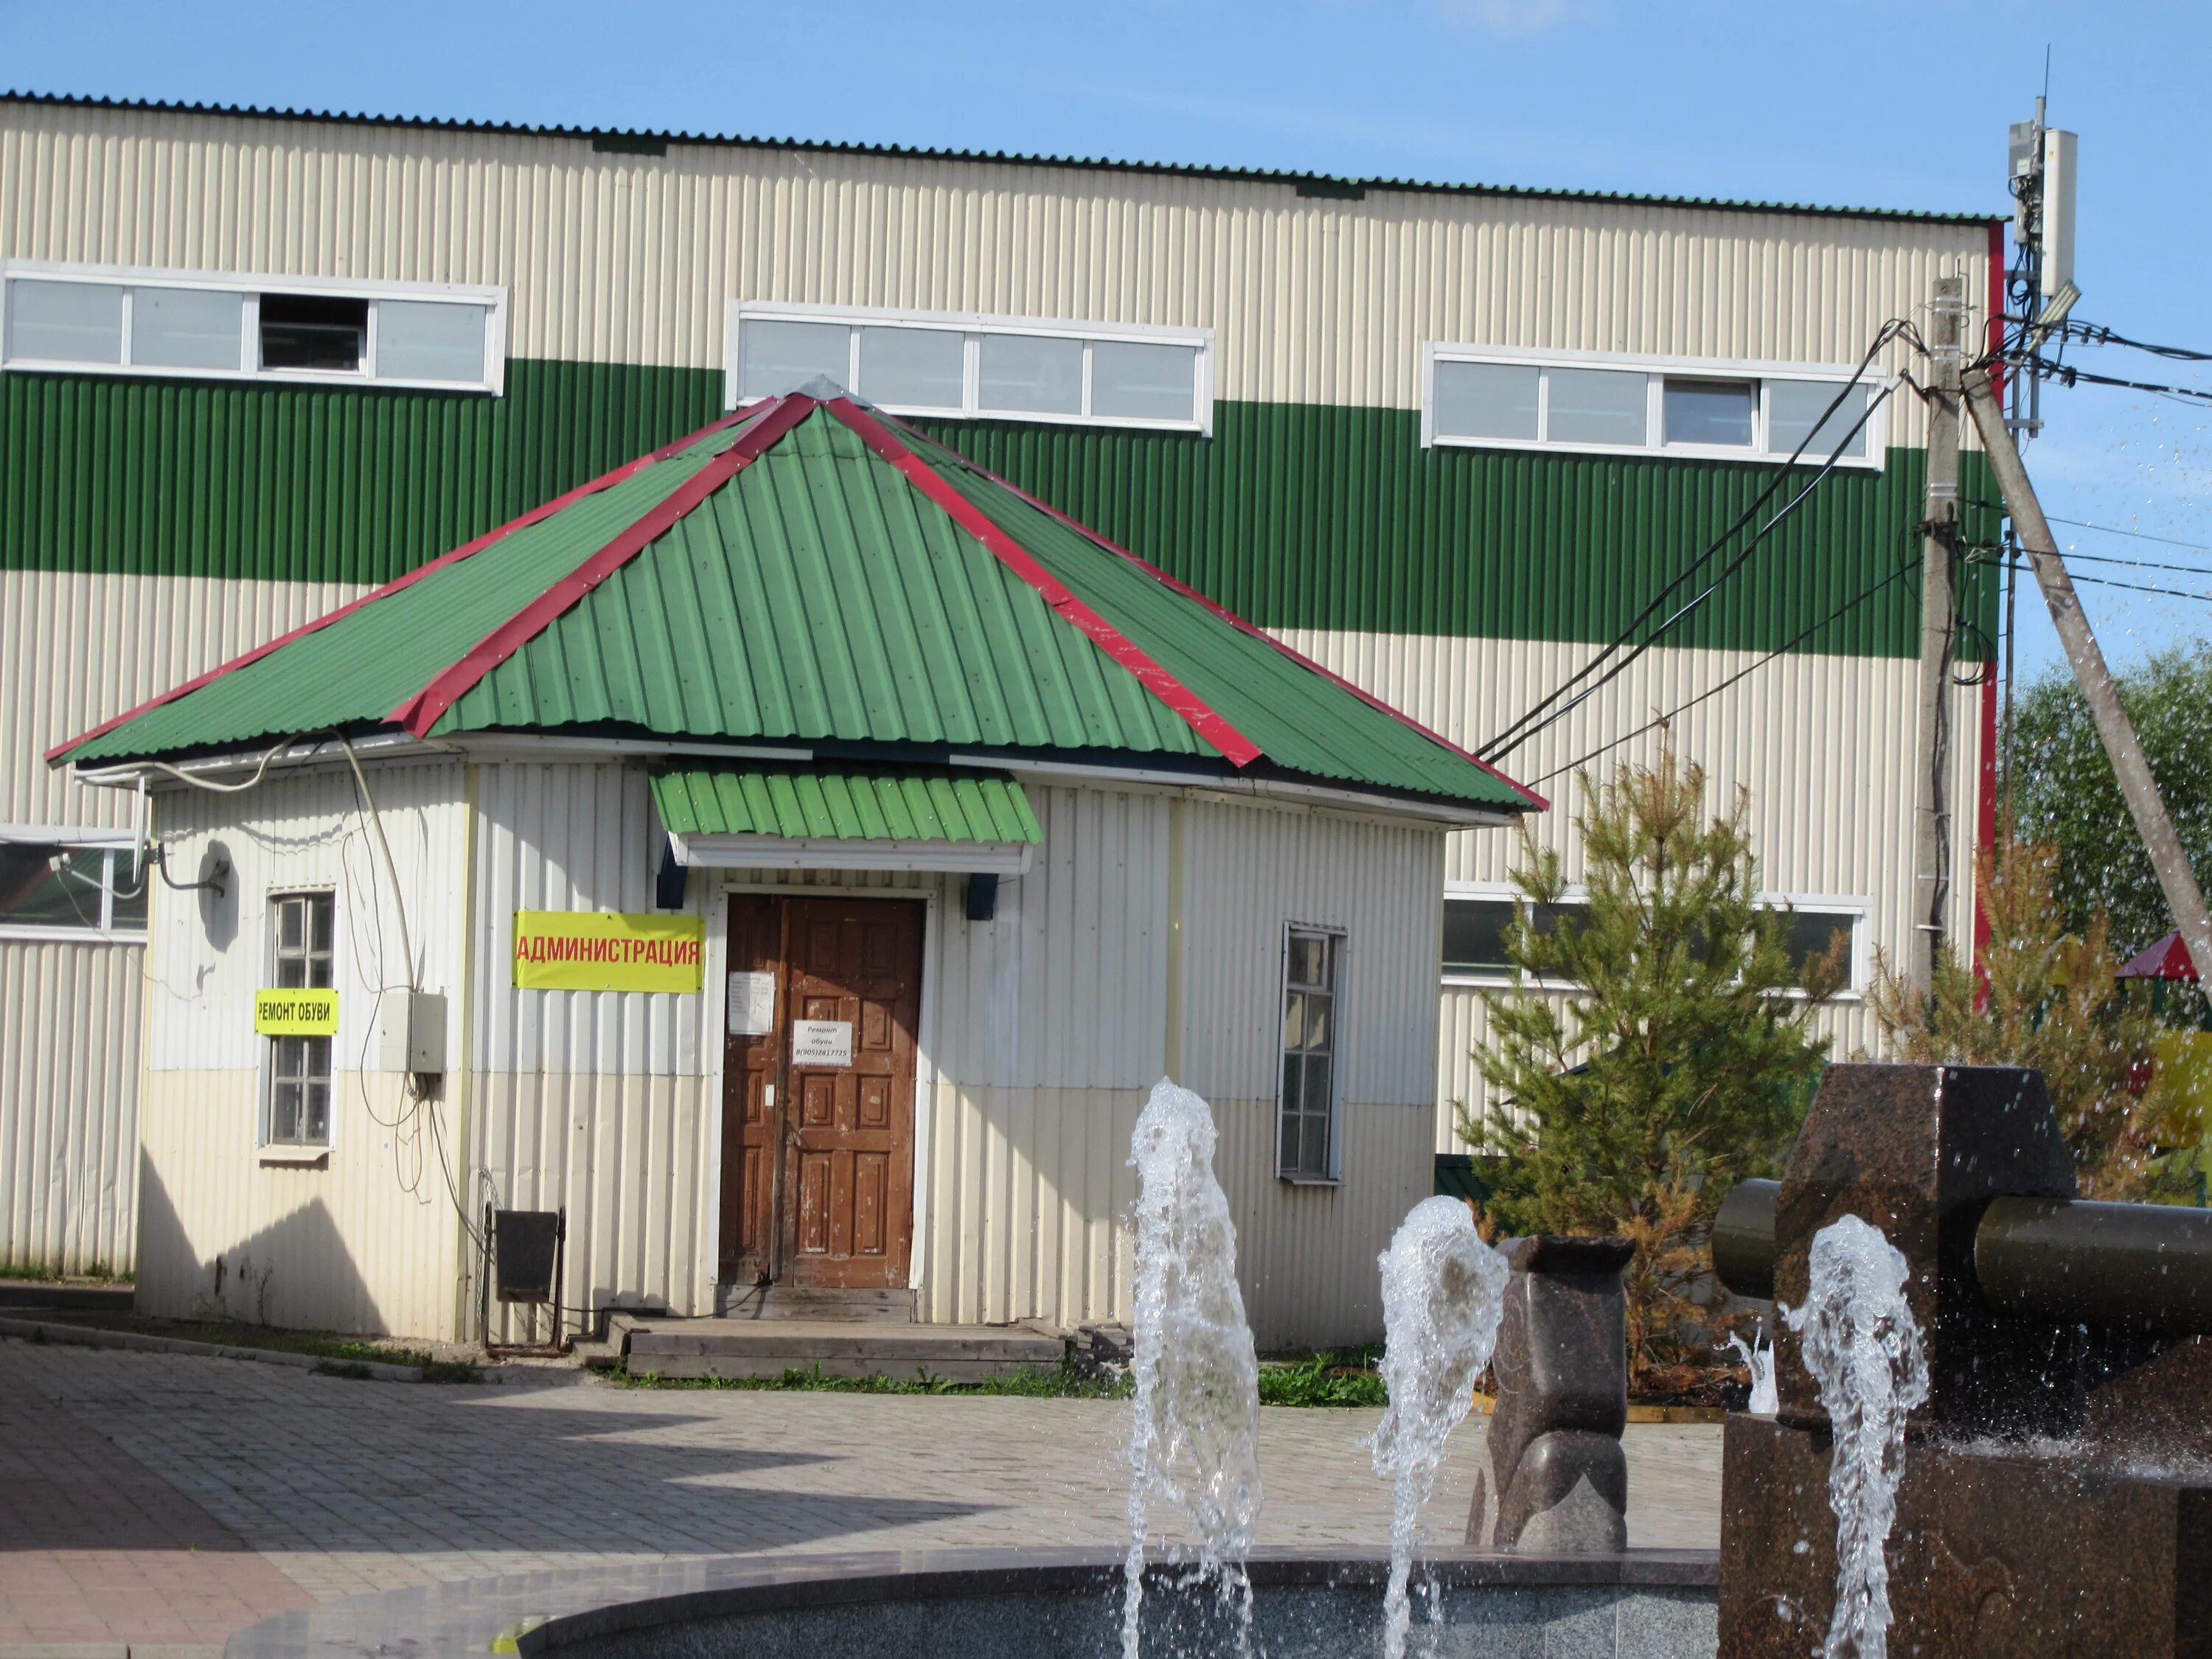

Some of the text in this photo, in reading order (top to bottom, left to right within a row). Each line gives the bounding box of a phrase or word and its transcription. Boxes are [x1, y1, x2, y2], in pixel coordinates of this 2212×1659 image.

[517, 936, 700, 967] АДМИНИСТРАЦИЯ
[259, 1002, 330, 1021] РЕМОНТ ОБУВИ
